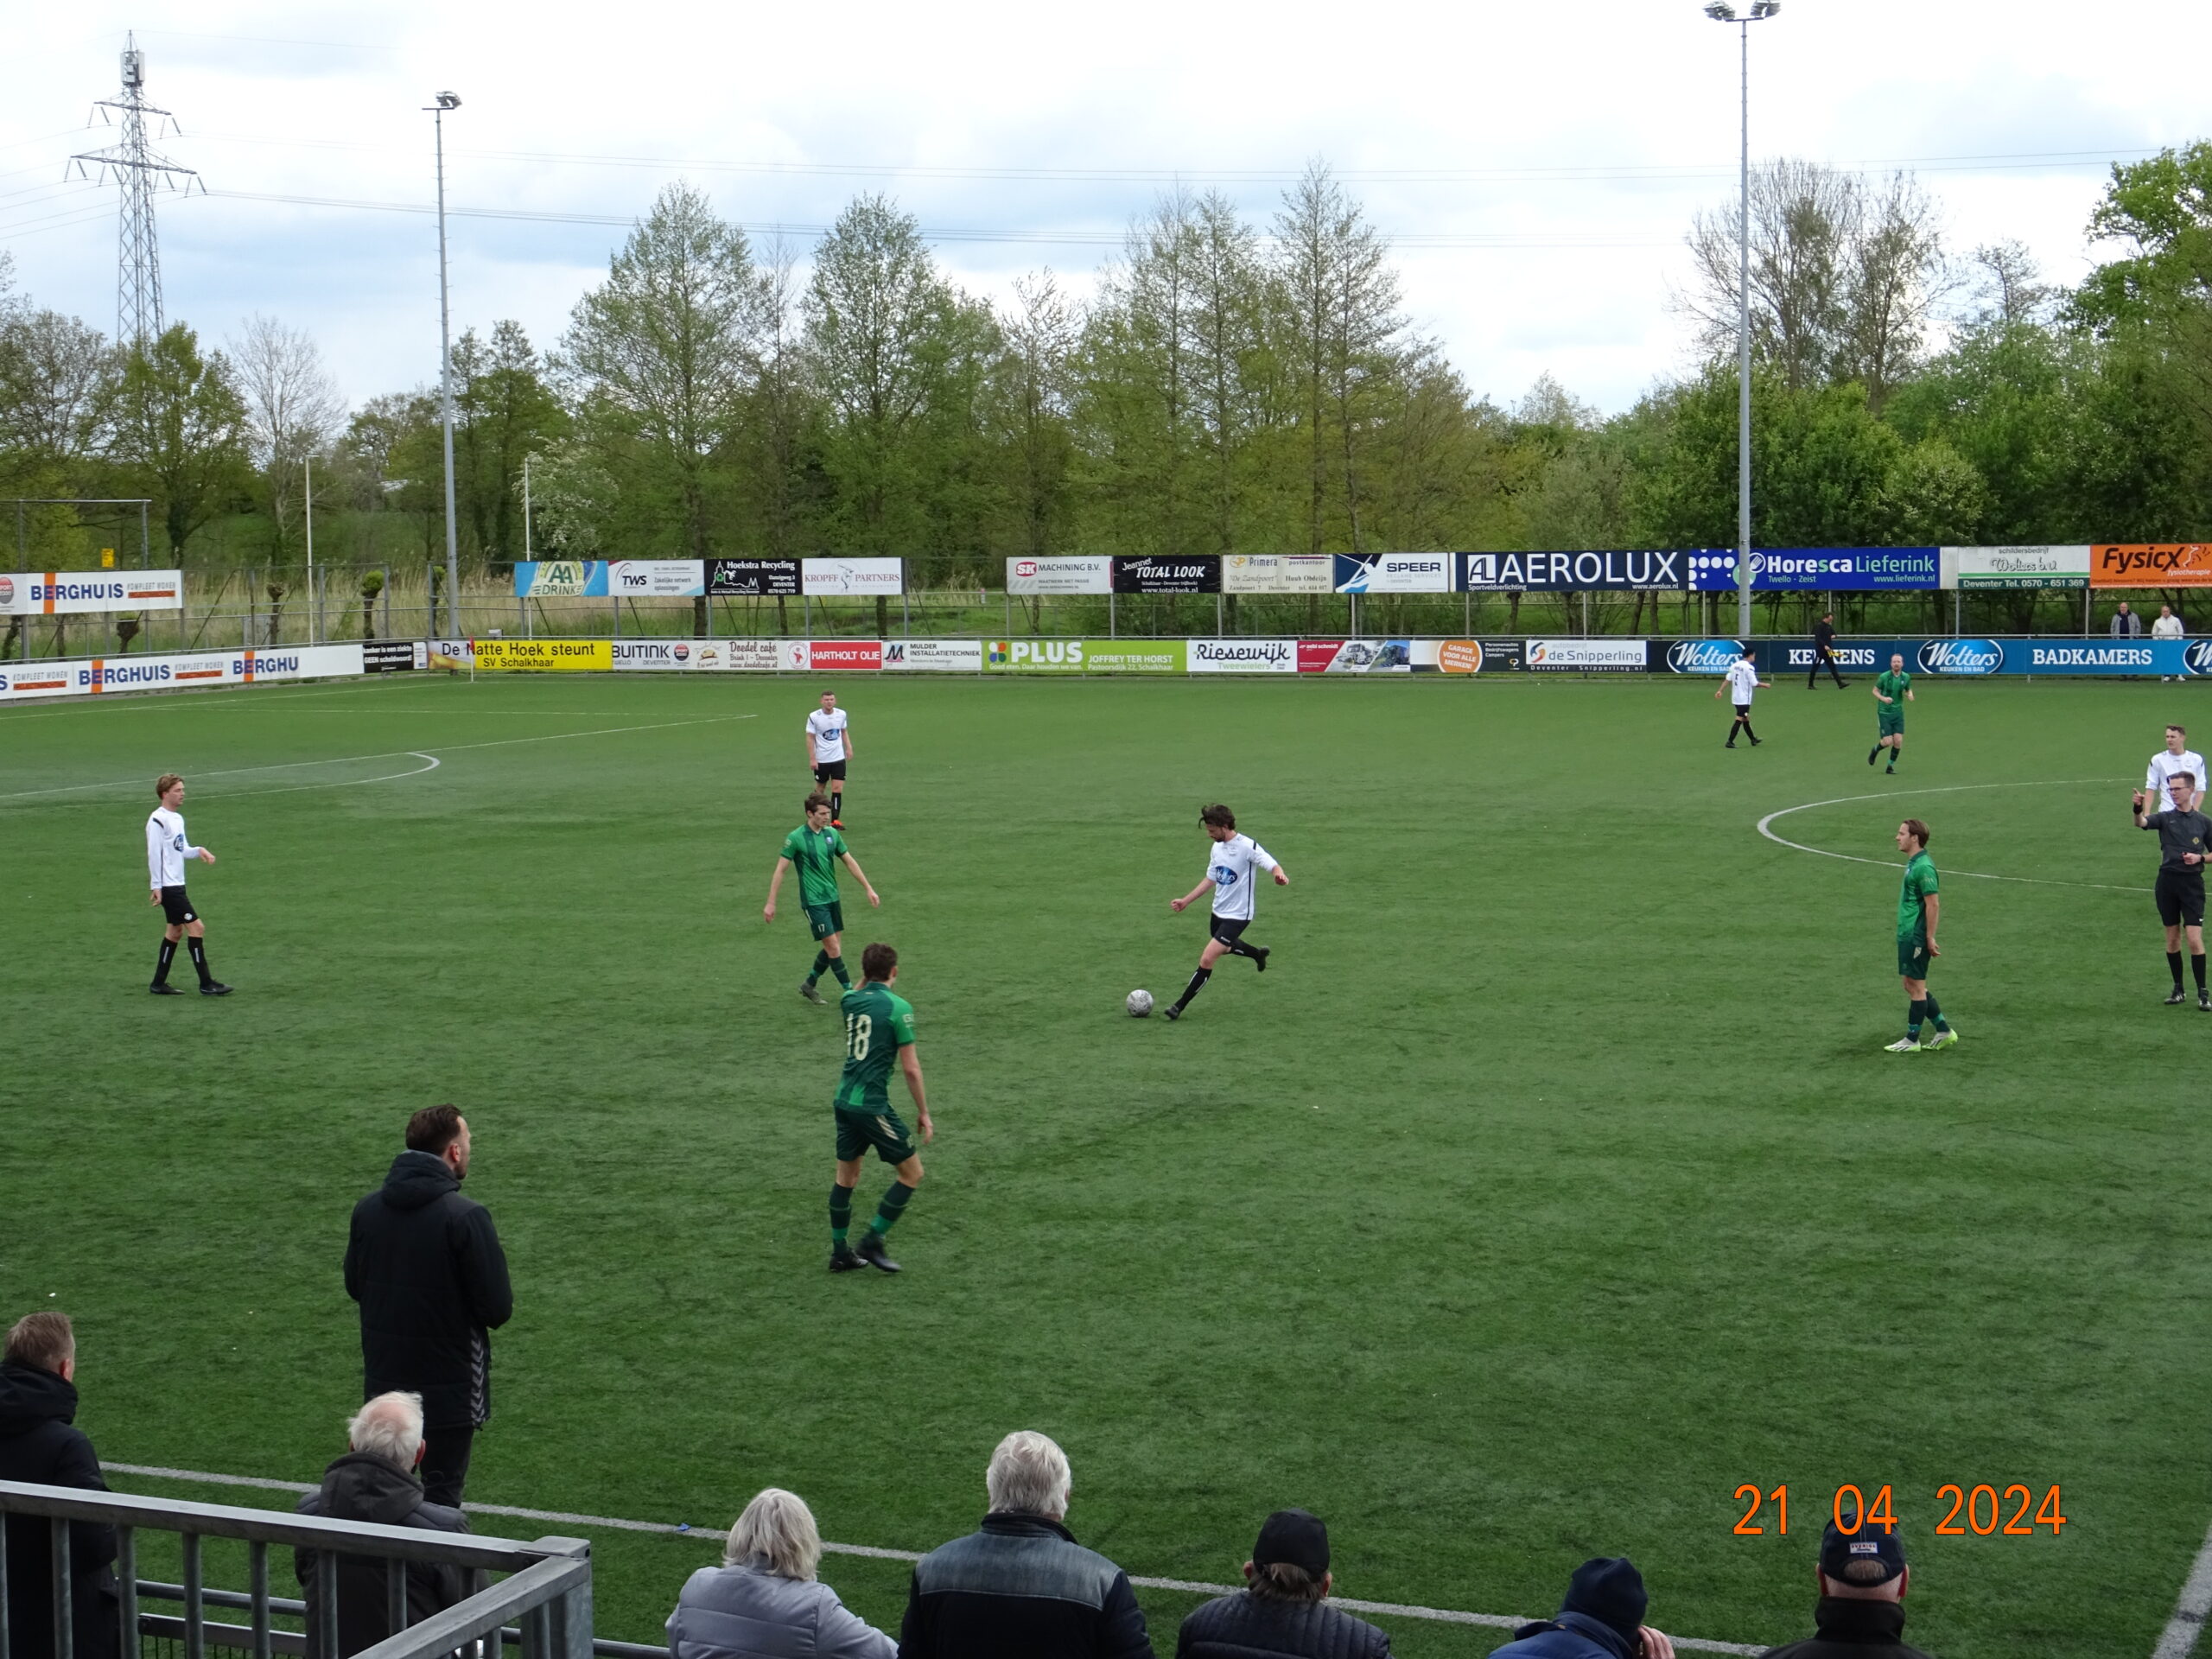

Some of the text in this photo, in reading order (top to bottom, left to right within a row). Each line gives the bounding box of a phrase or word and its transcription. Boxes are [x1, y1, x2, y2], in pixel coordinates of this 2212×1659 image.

[761, 561, 795, 570] Recycling
[1122, 557, 1153, 570] Jeannet
[1249, 557, 1278, 567] Primera
[1768, 555, 1935, 573] Horesca Lieferink
[2102, 546, 2185, 574] Fysicx
[548, 564, 574, 583] AA
[1016, 564, 1036, 575] SK
[1136, 566, 1205, 578] TOTAL LOOK
[1387, 563, 1441, 572] SPEER
[1498, 552, 1678, 583] AEROLUX
[622, 575, 647, 586] TWS
[804, 574, 838, 582] KROPFF
[1768, 575, 1791, 583] Twello
[1798, 575, 1816, 583] Zeist
[1873, 574, 1936, 582] www.lieferink.nl
[2004, 579, 2019, 588] Tel.
[30, 583, 124, 601] BERGHUIS
[542, 584, 577, 595] DRINK
[442, 643, 461, 656] De
[510, 643, 544, 656] Hoek
[551, 643, 594, 656] steunt
[612, 645, 670, 658] BUITINK
[811, 651, 880, 660] HARTHOLT OLIE
[1011, 642, 1084, 663] PLUS
[1196, 643, 1291, 664] Riesewijk
[1448, 645, 1473, 654] GARAGE
[1675, 643, 1743, 666] Wolters
[1926, 642, 1998, 666] Wolters
[483, 658, 554, 667] SV Schalkhaar
[1089, 655, 1173, 664] JOFFREY TER HORST
[1461, 654, 1477, 663] ALLE
[1548, 650, 1642, 664] de Snipperling
[1789, 649, 1875, 664] KEENS
[2032, 649, 2152, 665] BADKAMERS
[233, 657, 298, 675] BERGHU
[13, 671, 44, 681] KOMPLEET
[79, 664, 170, 685] BERGHUIS
[817, 924, 825, 932] 17
[846, 1013, 872, 1061] 18
